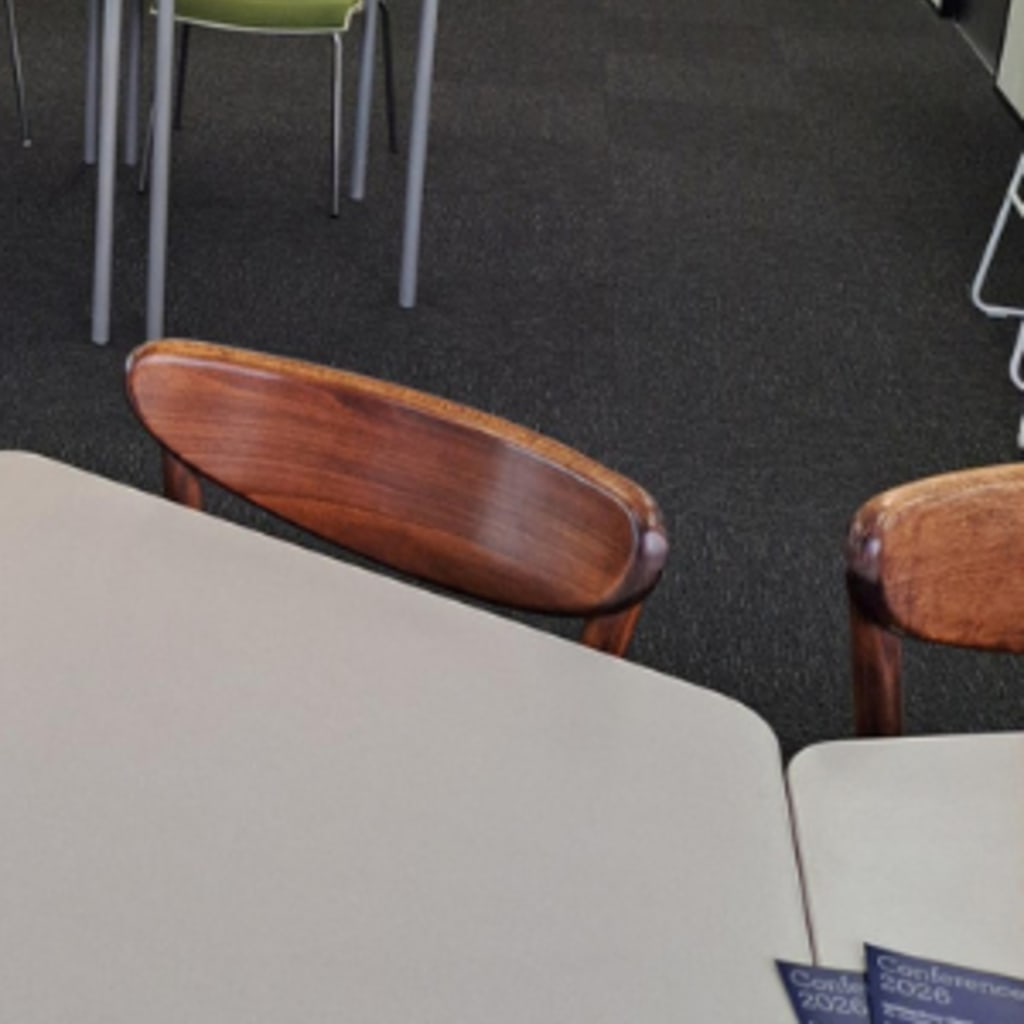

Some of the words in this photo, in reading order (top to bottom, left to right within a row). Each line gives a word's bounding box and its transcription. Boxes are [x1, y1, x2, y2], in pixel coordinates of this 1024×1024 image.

[877, 955, 1024, 999] Conference
[880, 971, 952, 1005] 2026
[797, 989, 869, 1016] 2026
